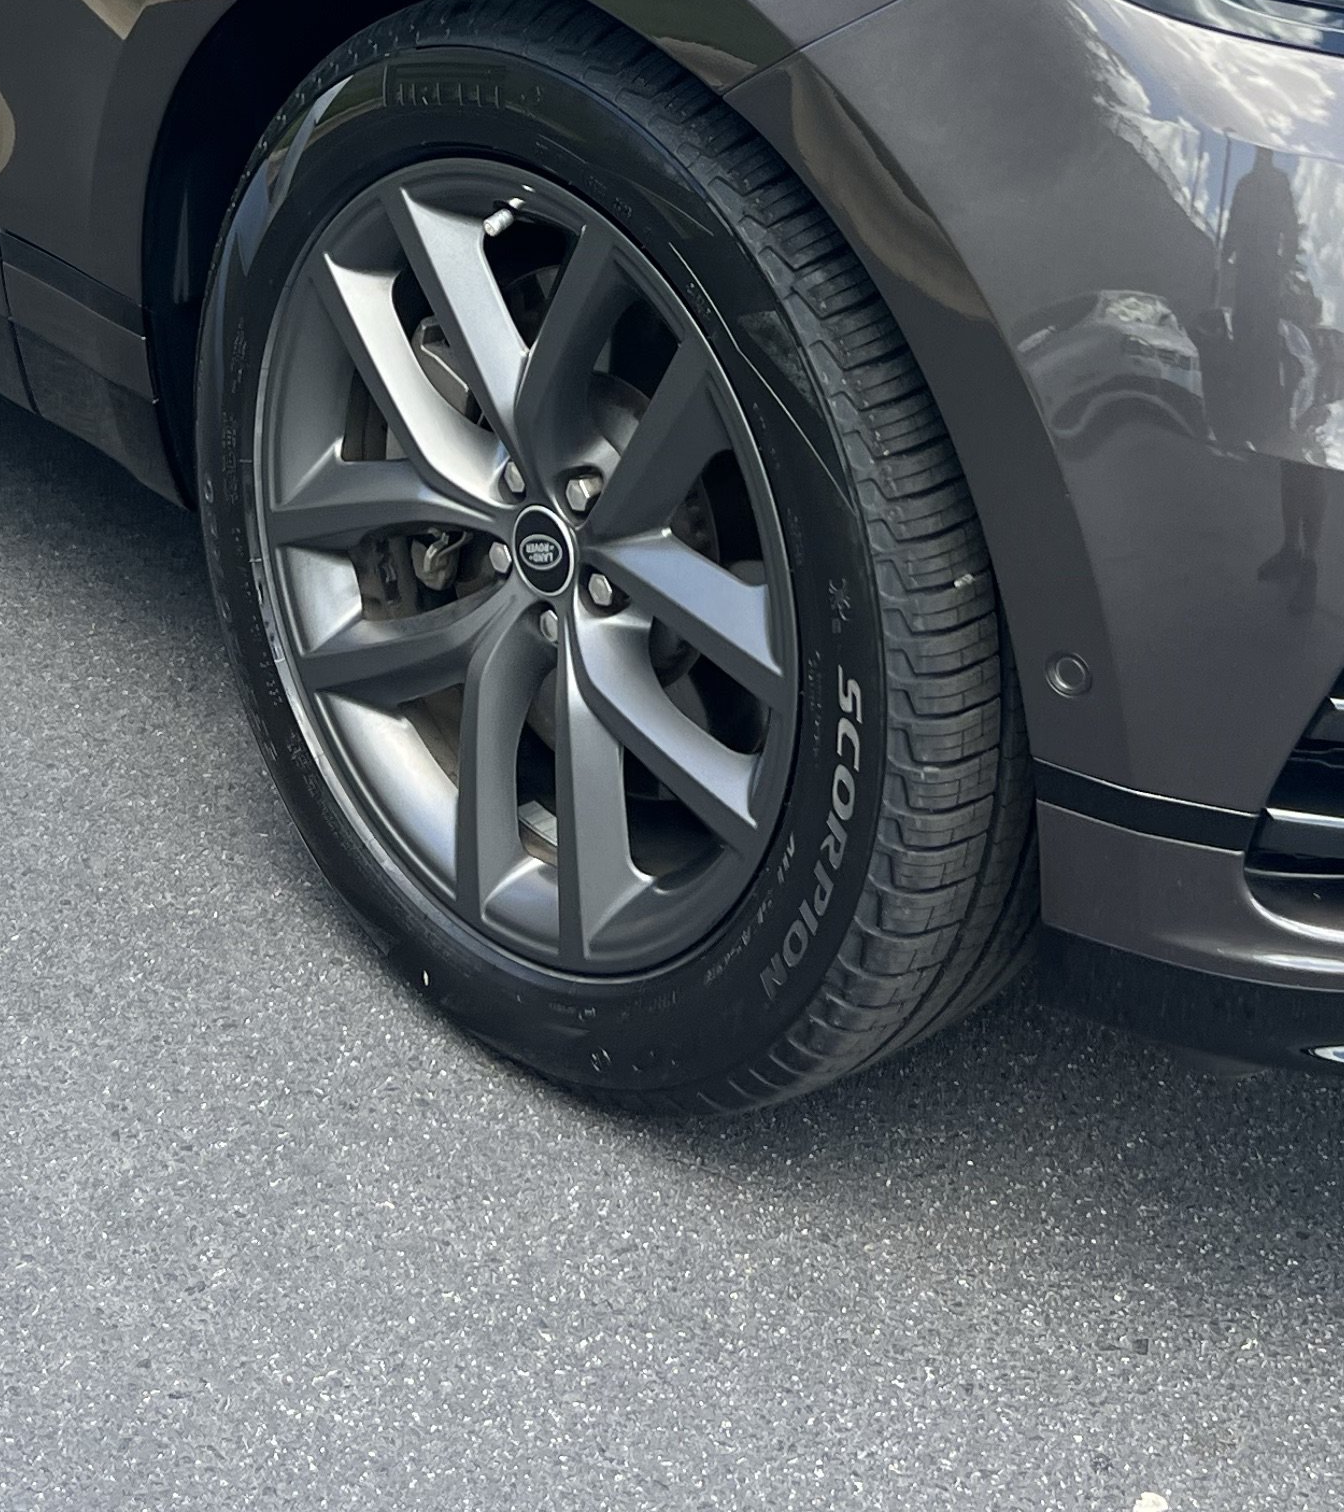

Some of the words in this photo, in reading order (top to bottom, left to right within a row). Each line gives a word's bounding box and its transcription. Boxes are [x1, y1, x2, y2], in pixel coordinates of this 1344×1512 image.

[526, 542, 550, 553] ROVER
[532, 551, 553, 563] LAND
[759, 664, 862, 1001] SCORPION
